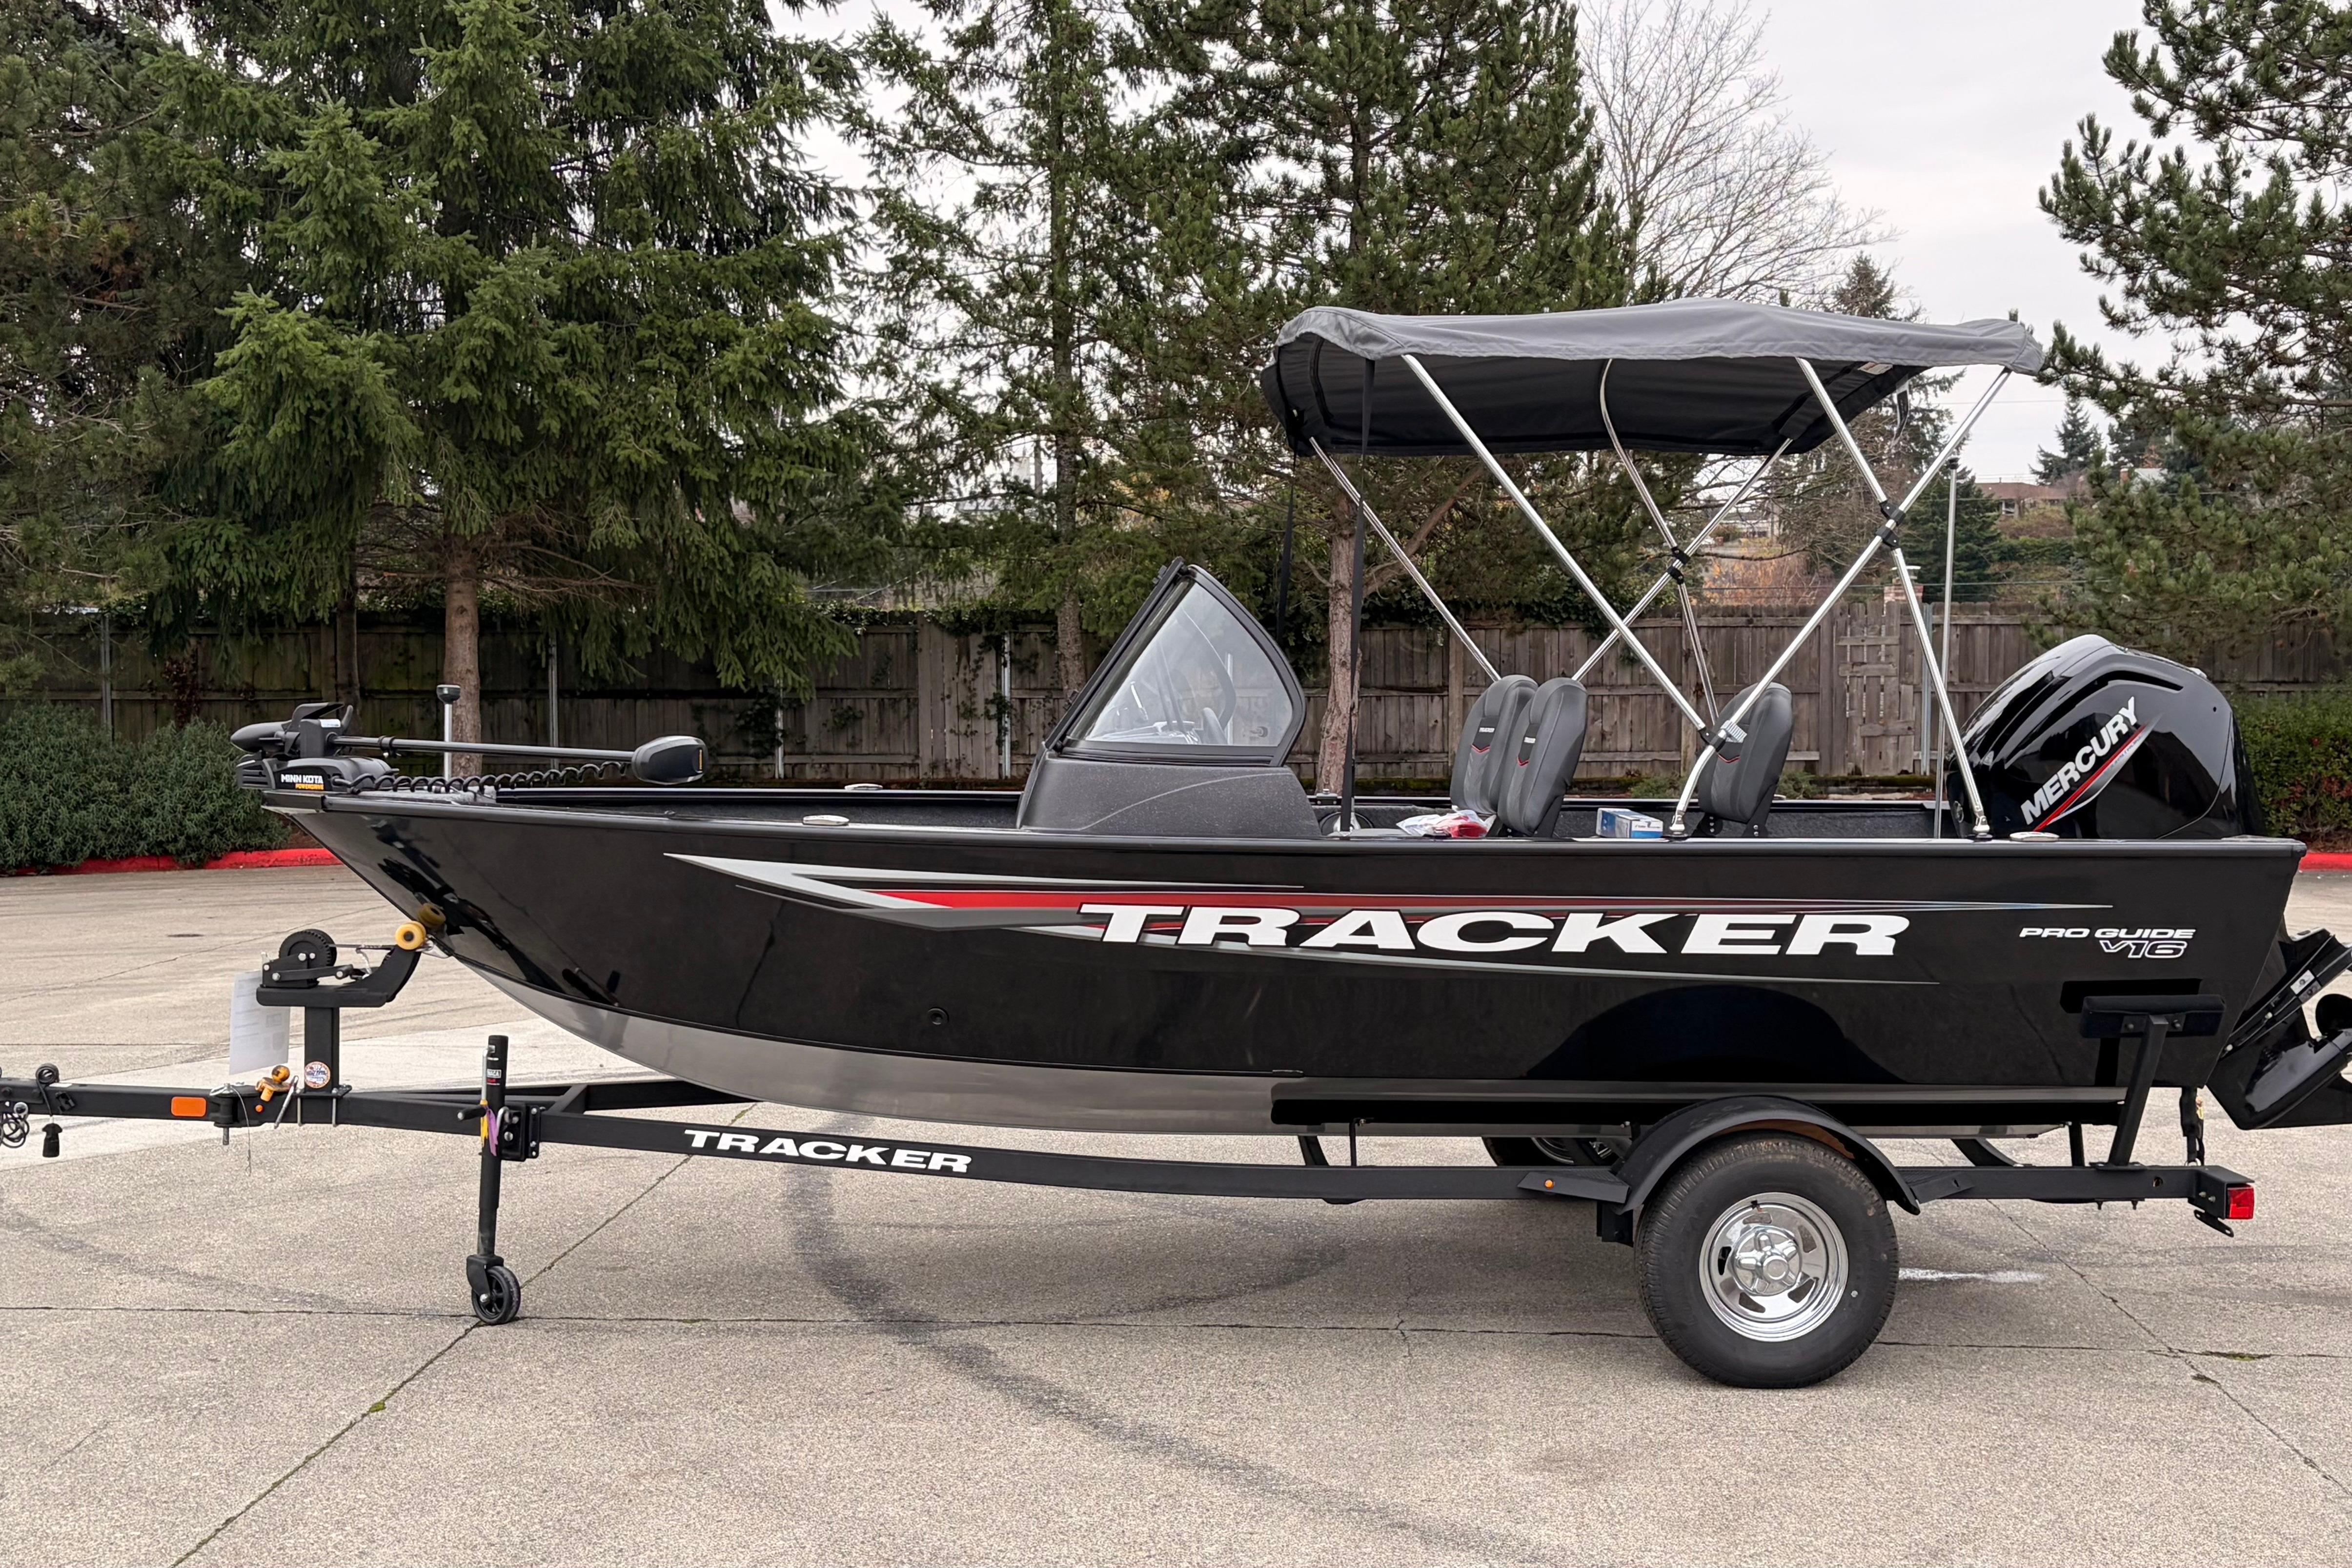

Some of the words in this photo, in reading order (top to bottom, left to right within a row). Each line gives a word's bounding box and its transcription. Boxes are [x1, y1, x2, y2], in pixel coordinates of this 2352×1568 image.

[2021, 696, 2137, 824] MERCURY
[281, 774, 302, 783] MINN
[303, 775, 324, 784] KOTA
[1080, 903, 1910, 956] TRACKER
[2019, 927, 2090, 938] PRO
[2094, 928, 2196, 938] GUIDE
[2099, 940, 2188, 958] V16
[684, 1129, 972, 1173] TRACKER
